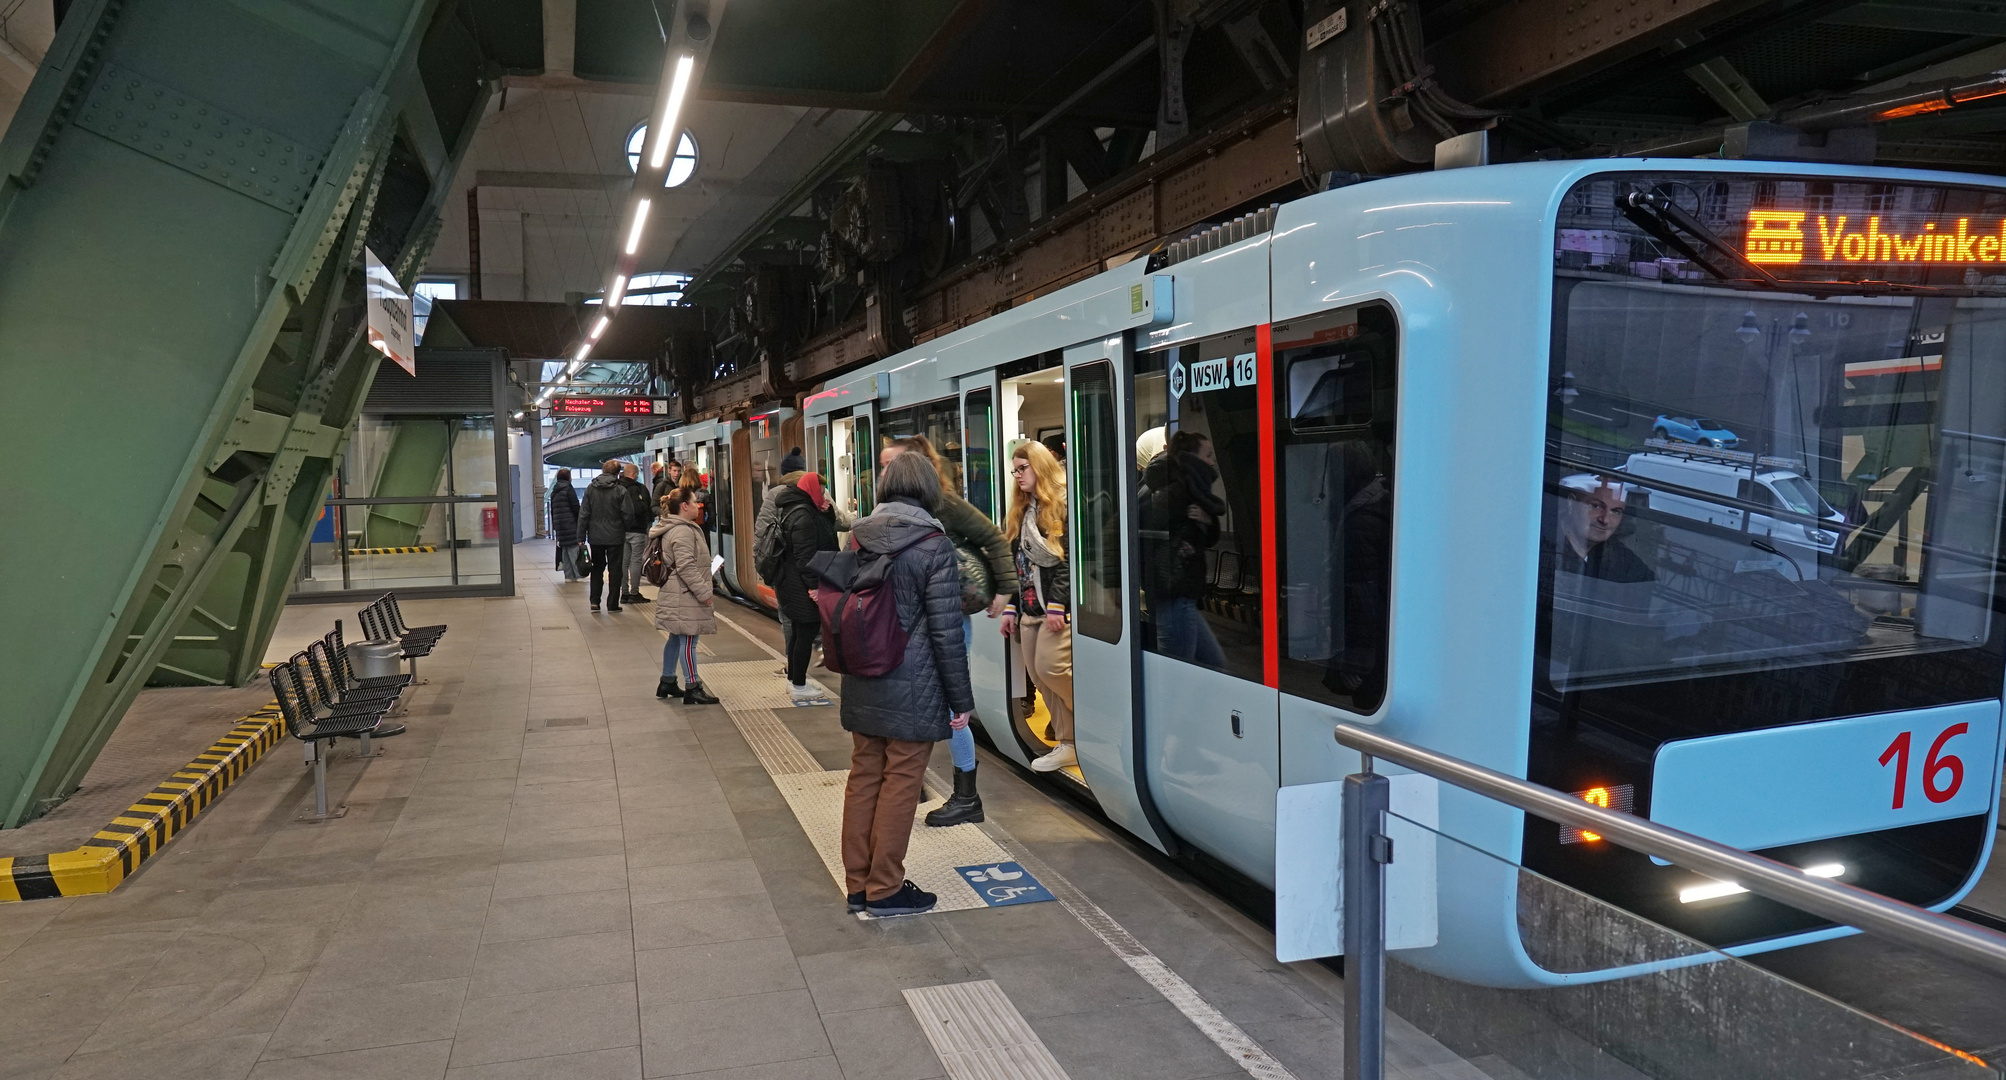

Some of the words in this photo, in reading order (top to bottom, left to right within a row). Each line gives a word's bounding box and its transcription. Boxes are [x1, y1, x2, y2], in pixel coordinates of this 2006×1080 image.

[1818, 215, 2006, 262] Vohwinkel
[1237, 358, 1253, 381] 16
[1878, 722, 1969, 810] 16
